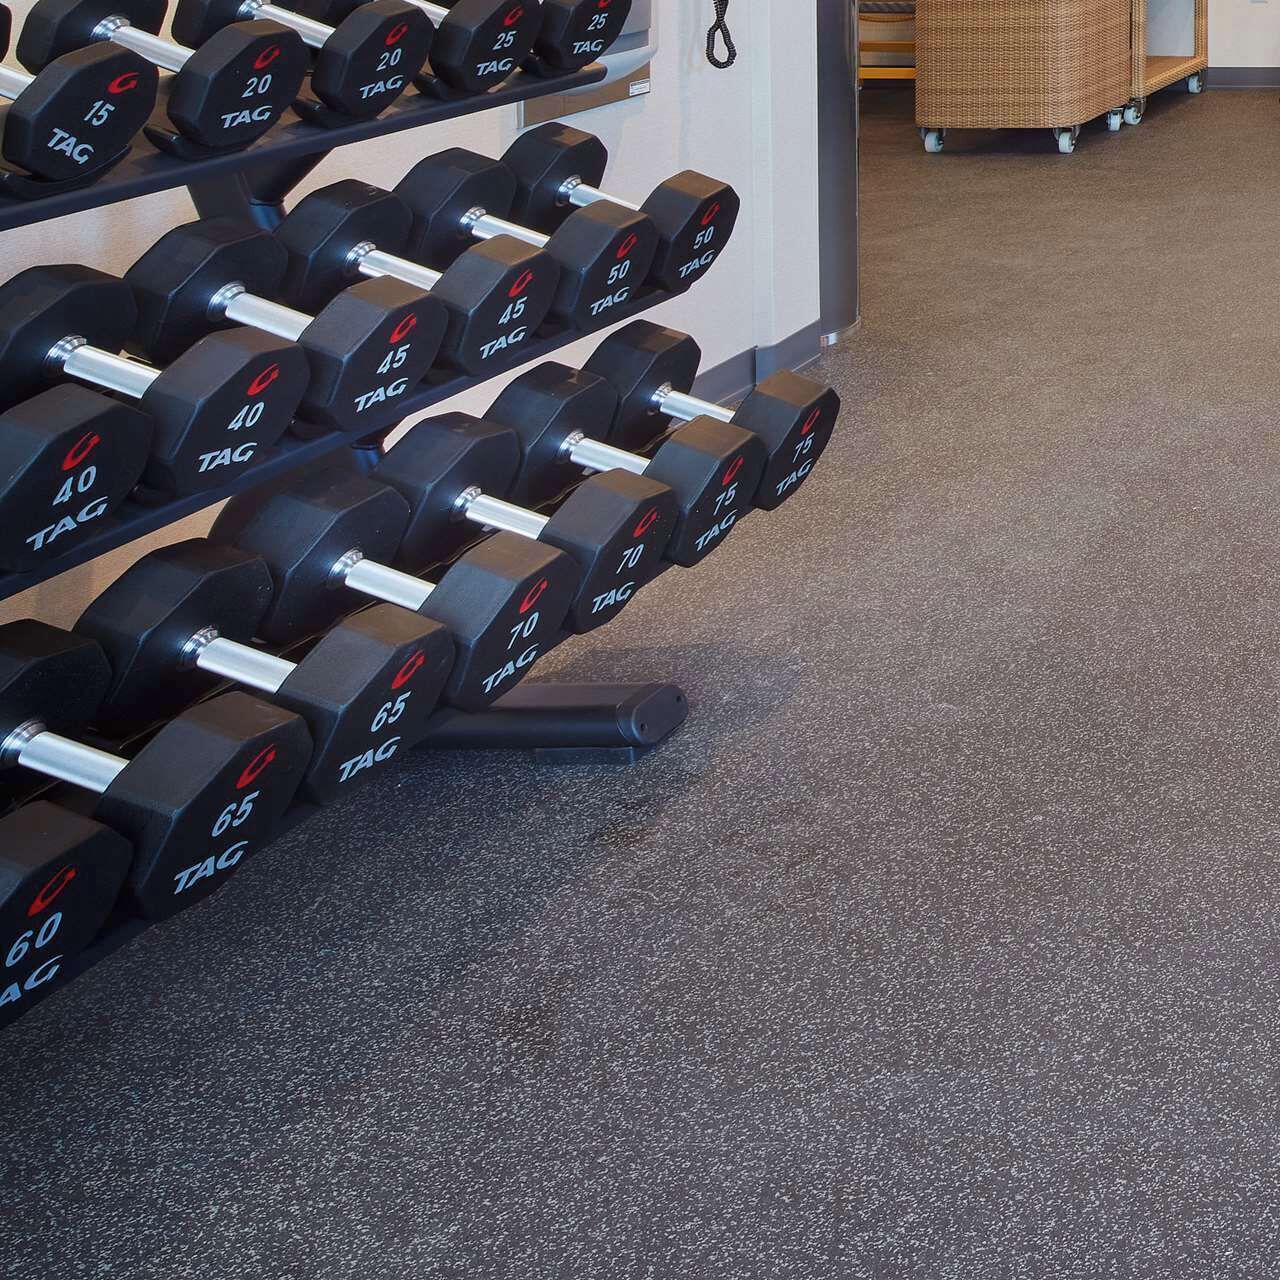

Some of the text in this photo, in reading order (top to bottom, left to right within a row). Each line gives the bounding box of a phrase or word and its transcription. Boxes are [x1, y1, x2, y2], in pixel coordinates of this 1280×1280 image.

[587, 12, 609, 31] 25
[492, 30, 517, 50] 25
[572, 39, 603, 55] TAG
[375, 48, 402, 70] 20
[476, 57, 513, 76] TAG
[241, 74, 272, 98] 20
[359, 74, 403, 99] TAG
[83, 100, 115, 126] 15
[220, 105, 272, 129] TAG
[47, 127, 95, 165] TAG
[693, 225, 714, 249] 50
[607, 259, 631, 285] 50
[679, 250, 715, 278] TAG
[497, 296, 527, 324] 45
[590, 286, 630, 316] TAG
[376, 343, 411, 374] 45
[479, 326, 527, 360] TAG
[353, 377, 409, 413] TAG
[227, 401, 265, 431] 40
[198, 442, 258, 473] TAG
[792, 432, 815, 463] 75
[52, 465, 97, 506] 40
[776, 458, 813, 496] TAG
[713, 481, 738, 516] 75
[25, 496, 108, 551] TAG
[695, 509, 738, 552] TAG
[615, 543, 645, 574] 70
[591, 581, 635, 614] TAG
[507, 611, 540, 651] 70
[482, 643, 539, 694] TAG
[370, 691, 411, 732] 65
[338, 736, 401, 783] TAG
[211, 790, 260, 837] 65
[173, 840, 249, 895] TAG
[5, 912, 63, 967] 60
[0, 954, 64, 1007] AG
